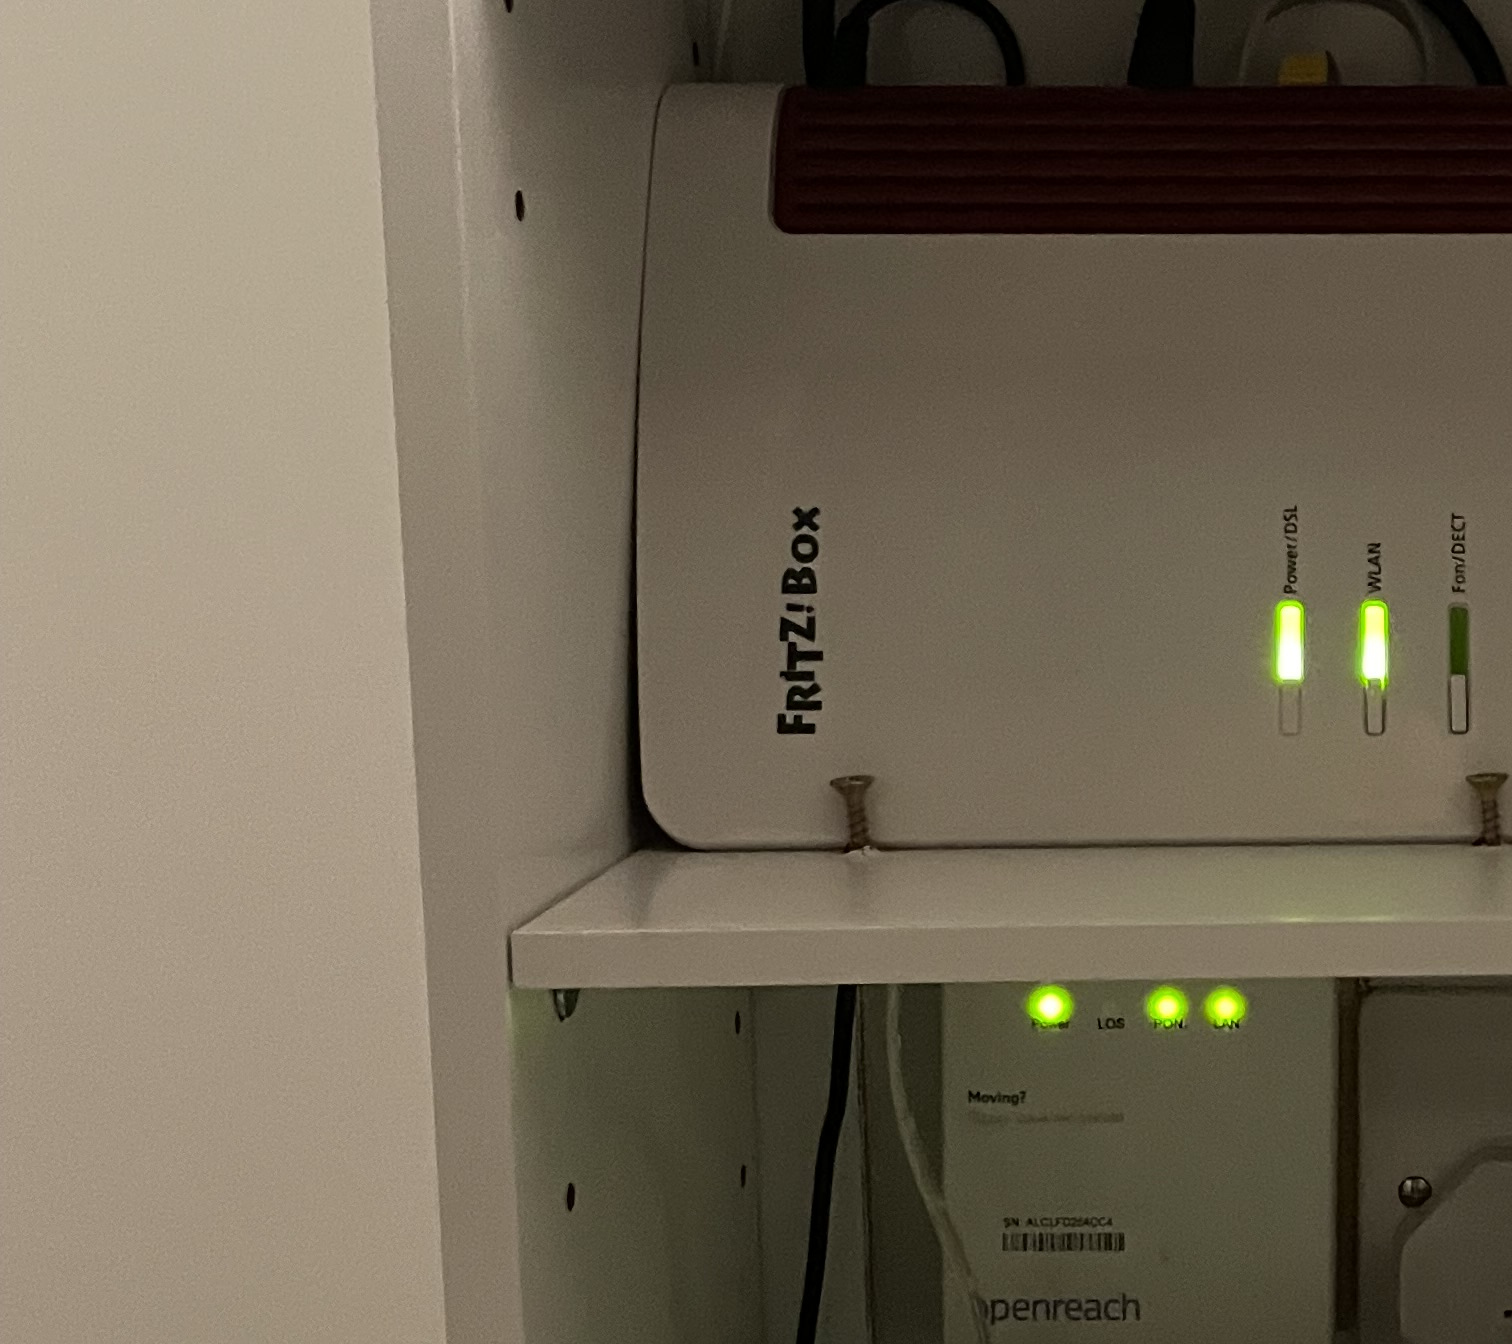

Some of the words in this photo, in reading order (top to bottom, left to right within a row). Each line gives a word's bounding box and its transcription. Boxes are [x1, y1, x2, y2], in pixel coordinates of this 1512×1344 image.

[1283, 504, 1299, 595] Power/DSL
[1367, 542, 1382, 594] WLAN
[1451, 512, 1466, 594] Fon/DECT
[1097, 1017, 1125, 1030] LOS
[967, 1090, 1027, 1106] Moving?
